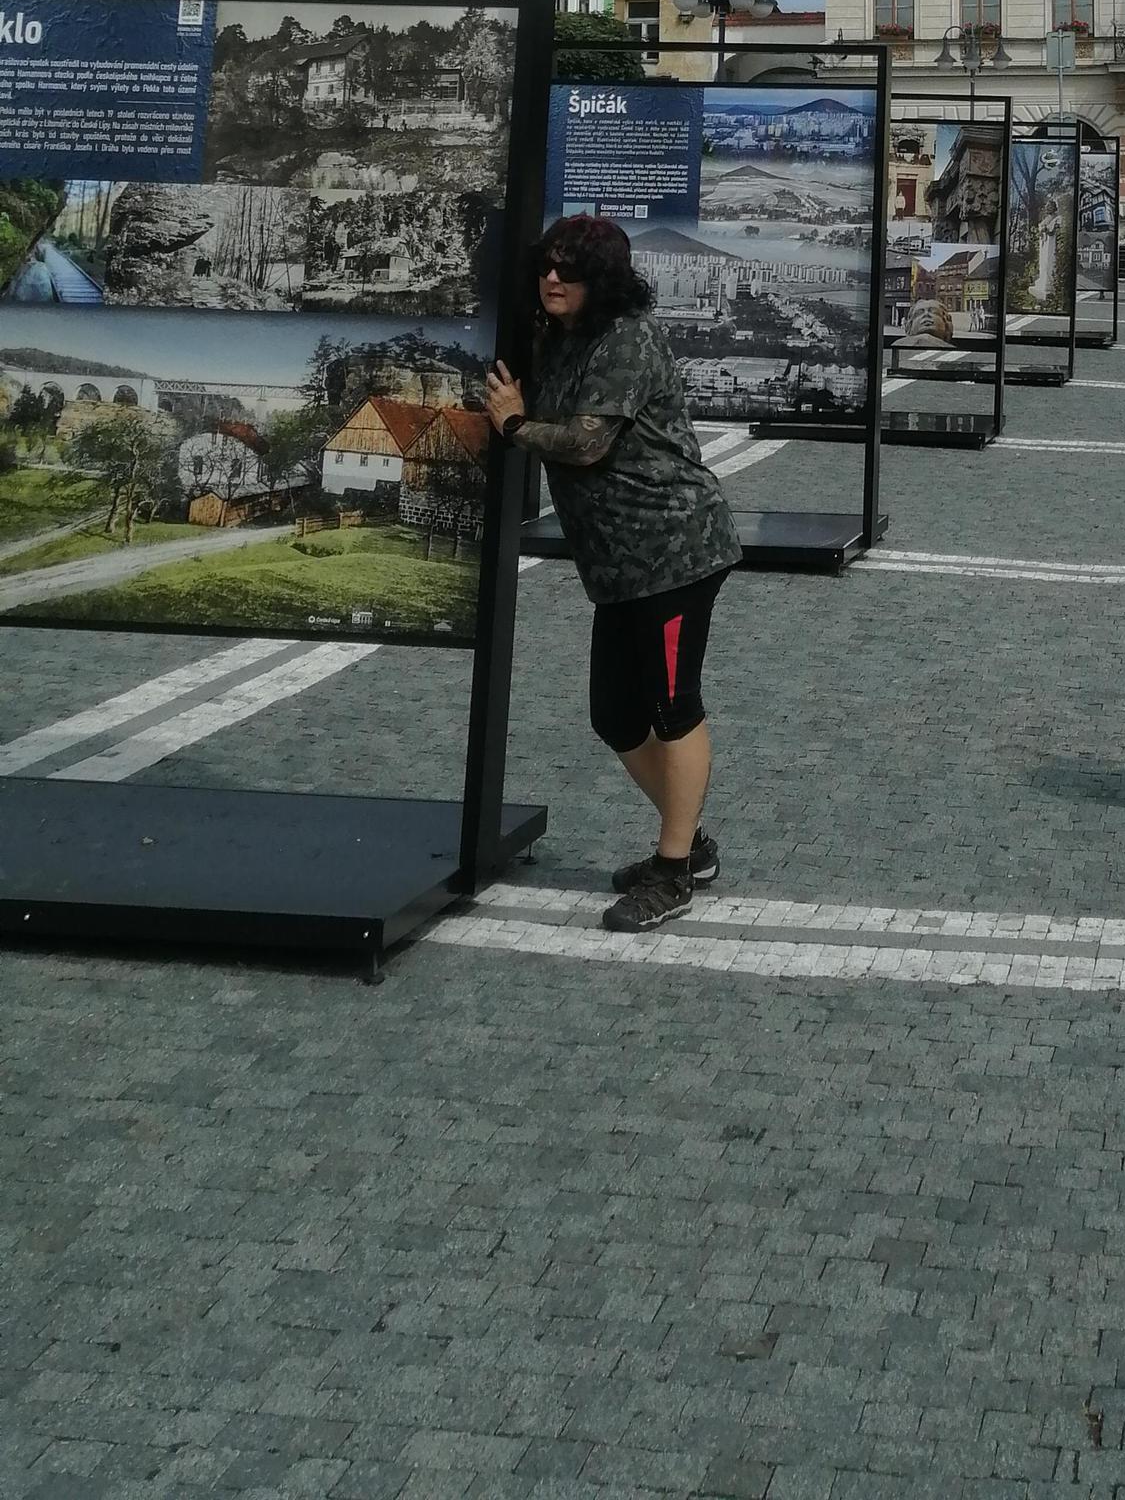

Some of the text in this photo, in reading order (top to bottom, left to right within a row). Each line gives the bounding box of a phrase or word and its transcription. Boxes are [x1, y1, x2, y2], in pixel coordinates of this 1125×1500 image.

[0, 12, 42, 44] klo
[160, 63, 177, 72] cesty
[76, 71, 93, 80] podle
[70, 81, 87, 92] který
[89, 82, 108, 92] svými
[111, 82, 129, 93] výlety
[132, 84, 140, 92] do
[162, 85, 175, 93] toto
[568, 89, 628, 117] Špičák
[34, 105, 45, 117] být
[53, 108, 84, 117] posledních
[72, 120, 79, 128] do
[80, 118, 98, 128] České
[60, 131, 79, 141] stavby
[140, 133, 148, 141] do
[176, 147, 192, 155] most
